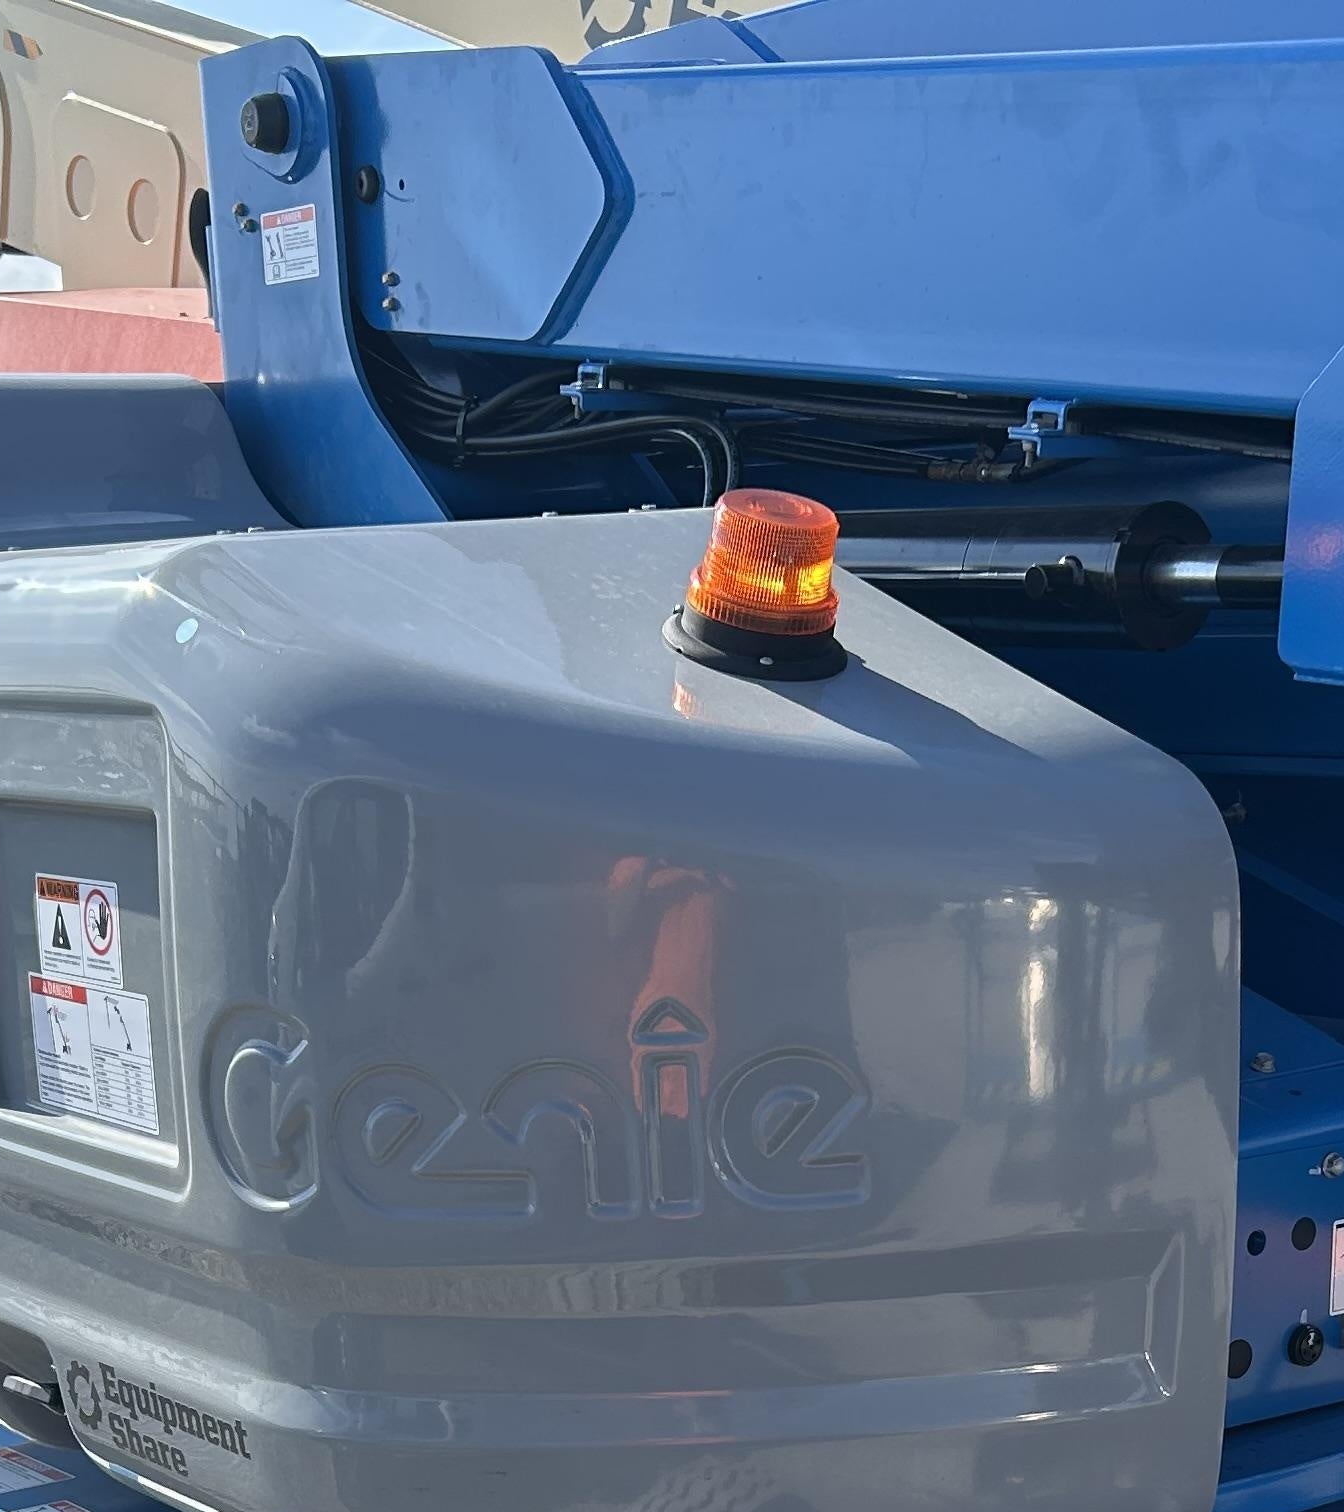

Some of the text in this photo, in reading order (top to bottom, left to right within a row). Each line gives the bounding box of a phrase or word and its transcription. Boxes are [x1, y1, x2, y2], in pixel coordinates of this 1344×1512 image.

[199, 997, 871, 1222] Genie
[98, 1362, 252, 1460] Equipment
[108, 1412, 189, 1477] Share
